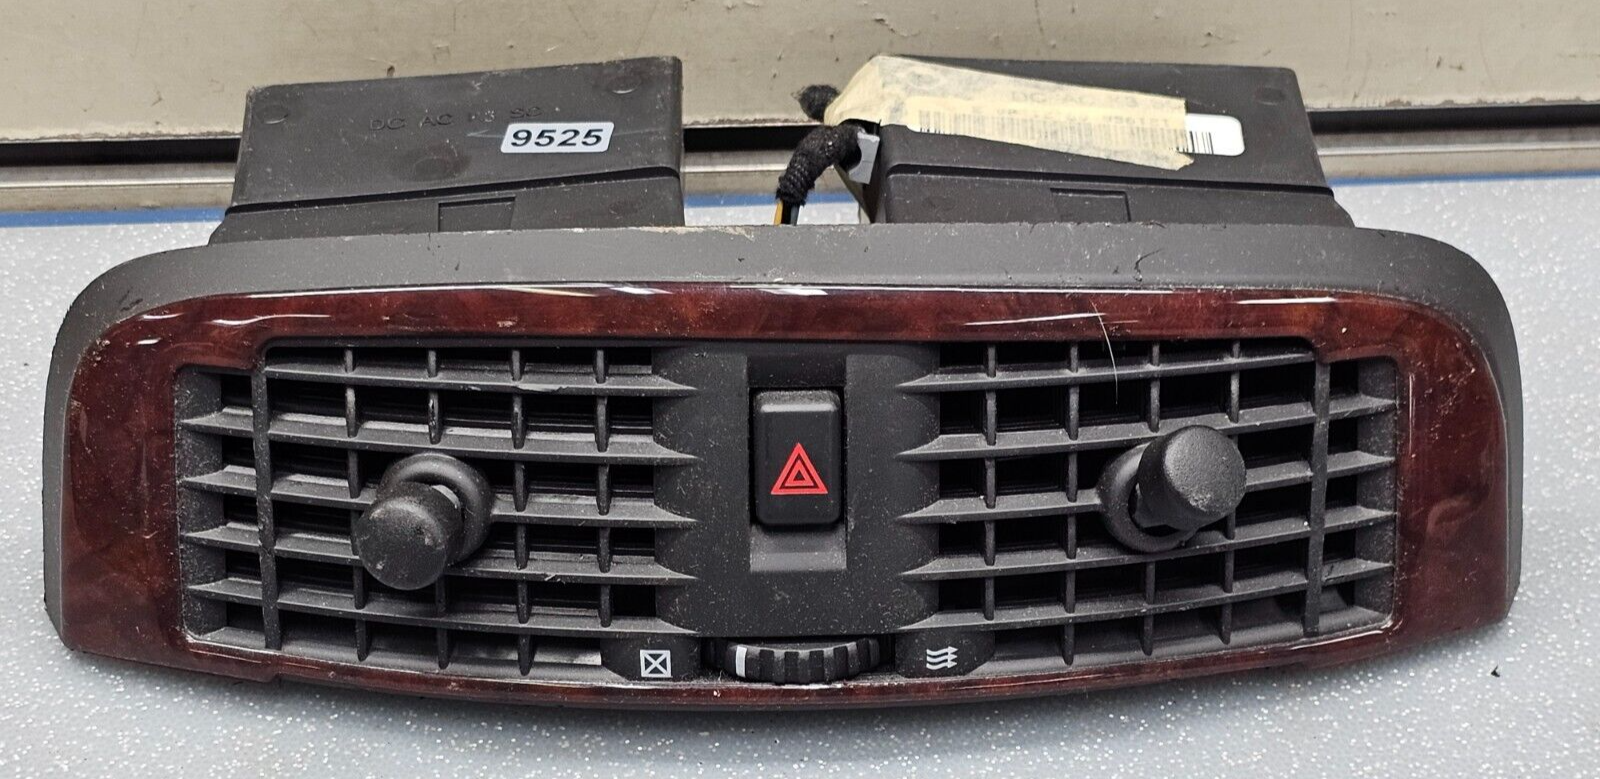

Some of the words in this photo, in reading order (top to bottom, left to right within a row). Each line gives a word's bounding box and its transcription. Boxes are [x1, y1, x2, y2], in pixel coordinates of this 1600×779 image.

[369, 118, 406, 131] DC
[419, 113, 453, 128] AC
[511, 129, 604, 147] 9525
